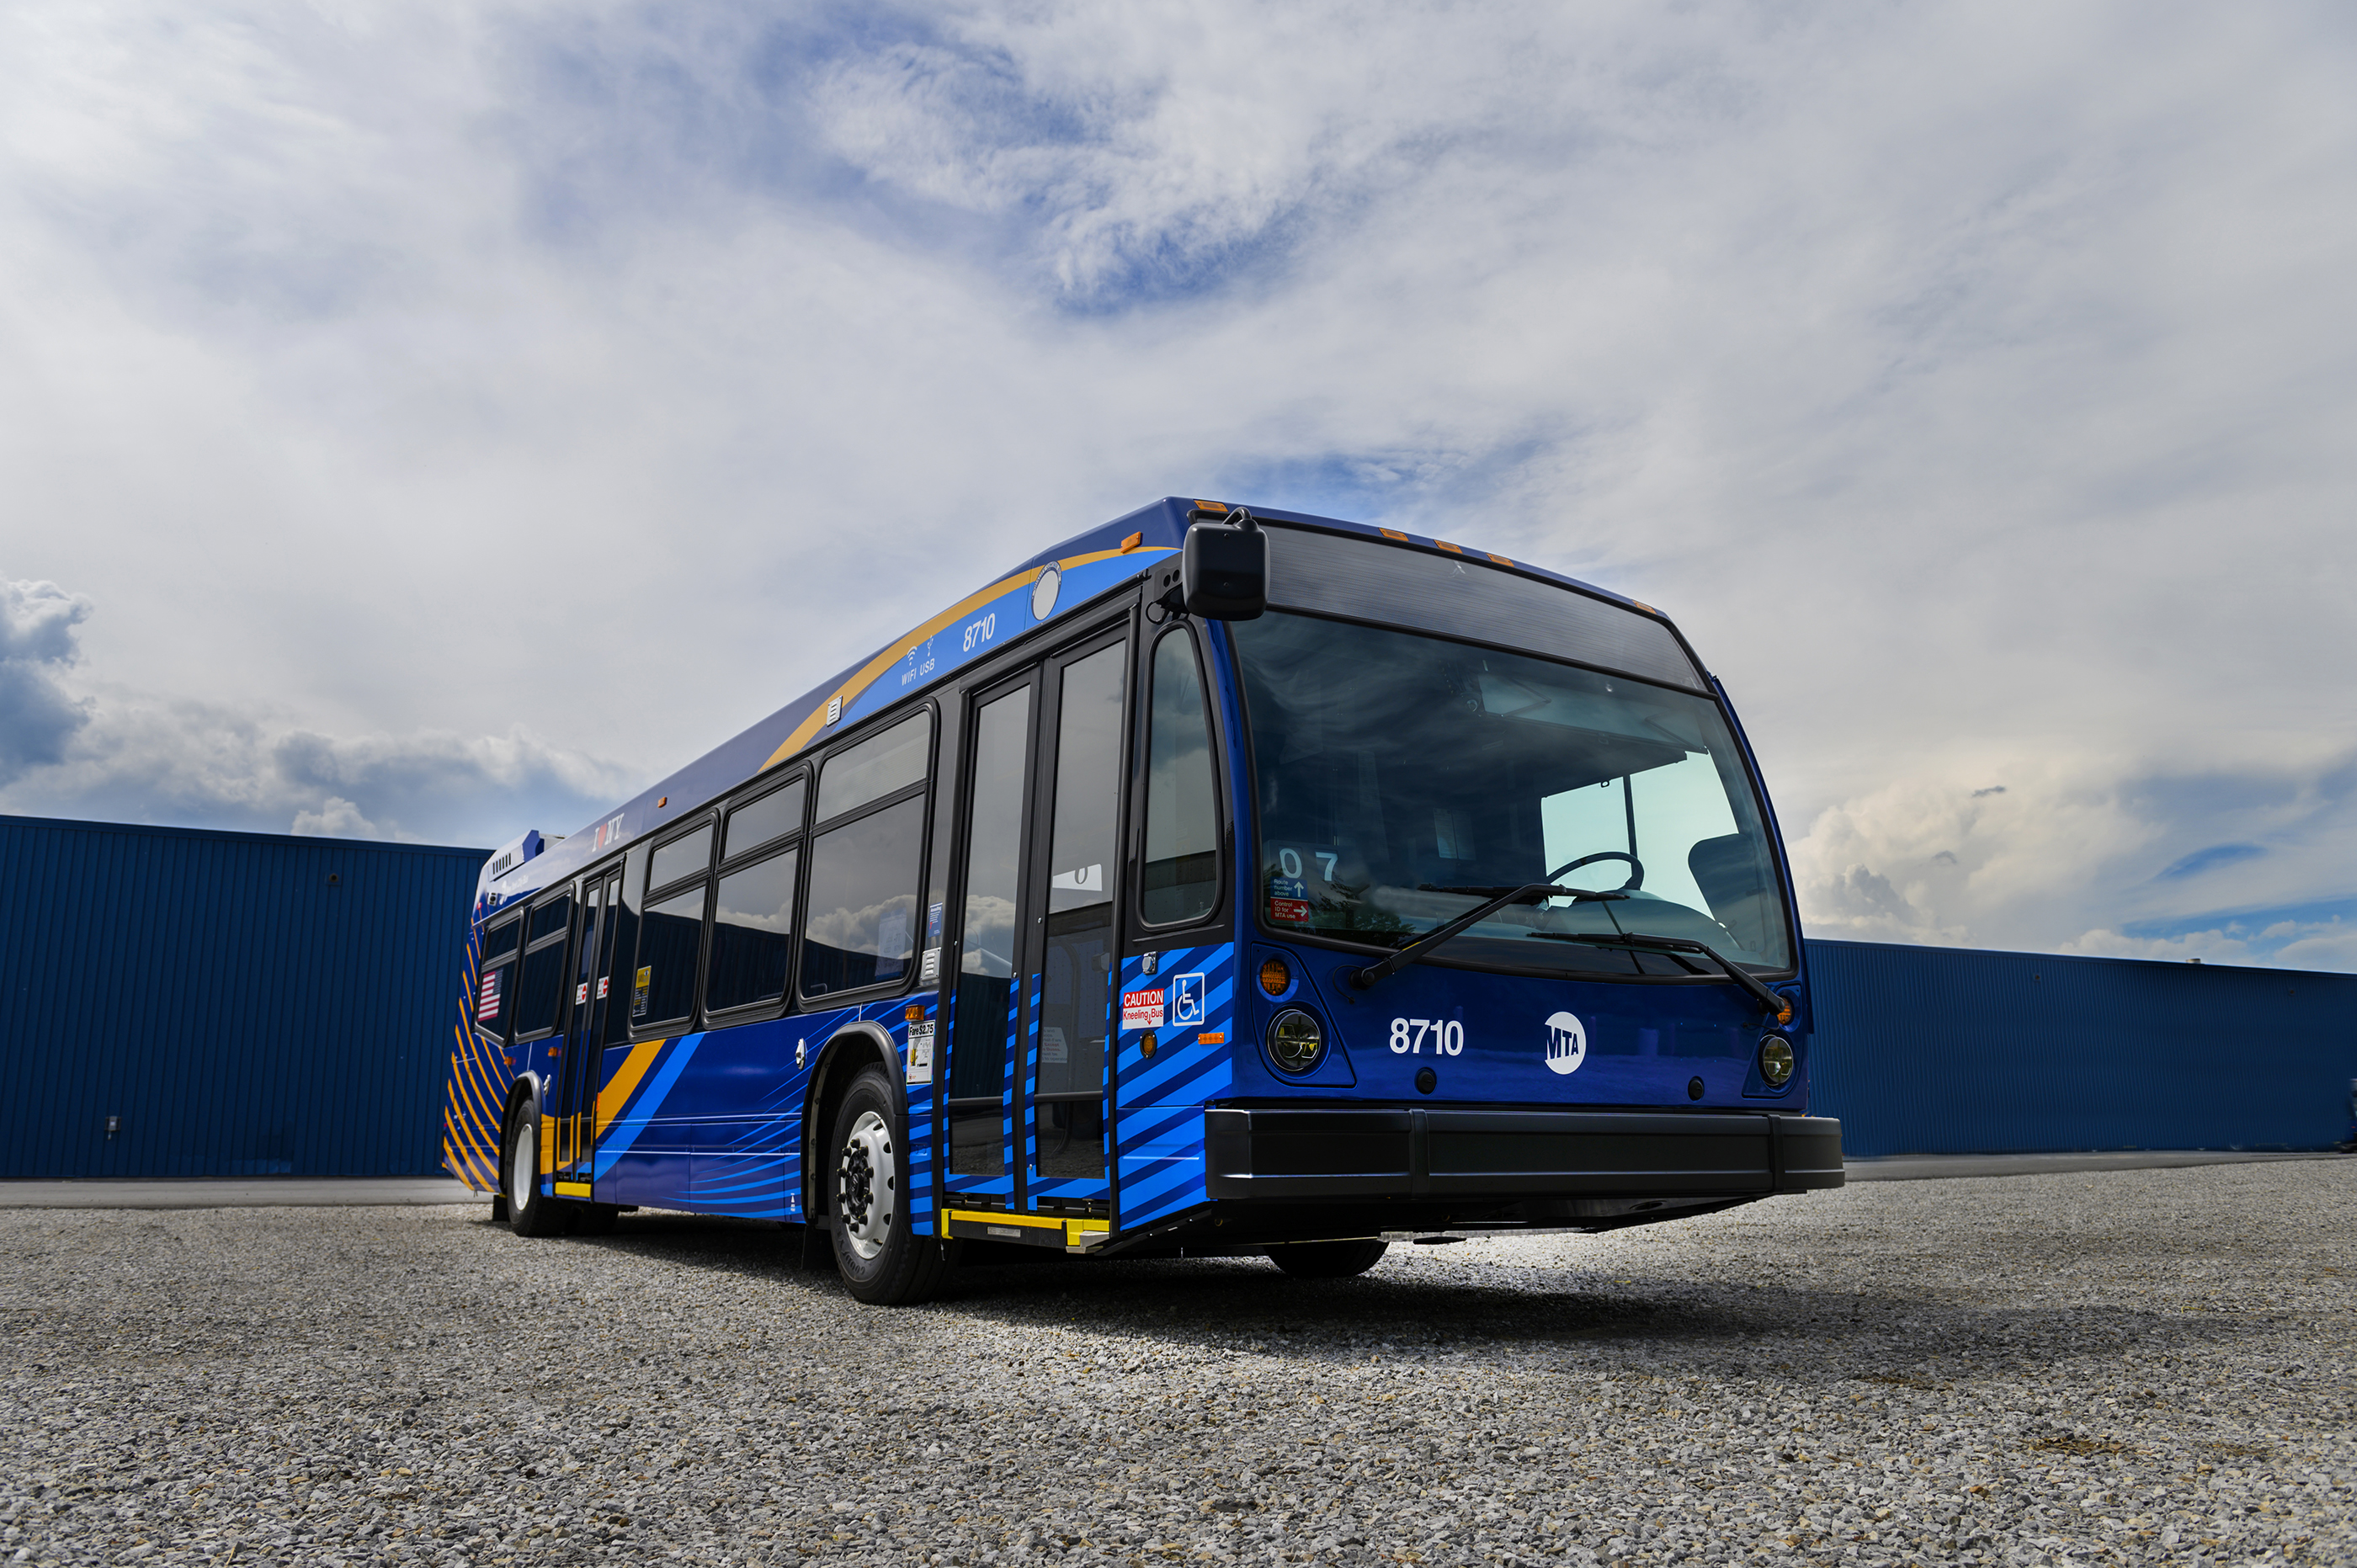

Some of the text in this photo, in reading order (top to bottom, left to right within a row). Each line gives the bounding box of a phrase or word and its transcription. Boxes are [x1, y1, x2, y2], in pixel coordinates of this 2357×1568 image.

[963, 613, 996, 652] 8710
[902, 658, 935, 686] WIFI USB
[604, 812, 625, 846] NY
[1280, 848, 1338, 882] 0 7
[1123, 1007, 1163, 1021] Kneeling Bus
[1124, 991, 1163, 1007] CAUTION
[909, 1023, 934, 1036] Fare $2.75
[1389, 1017, 1465, 1056] 8710
[1545, 1023, 1581, 1062] MTA
